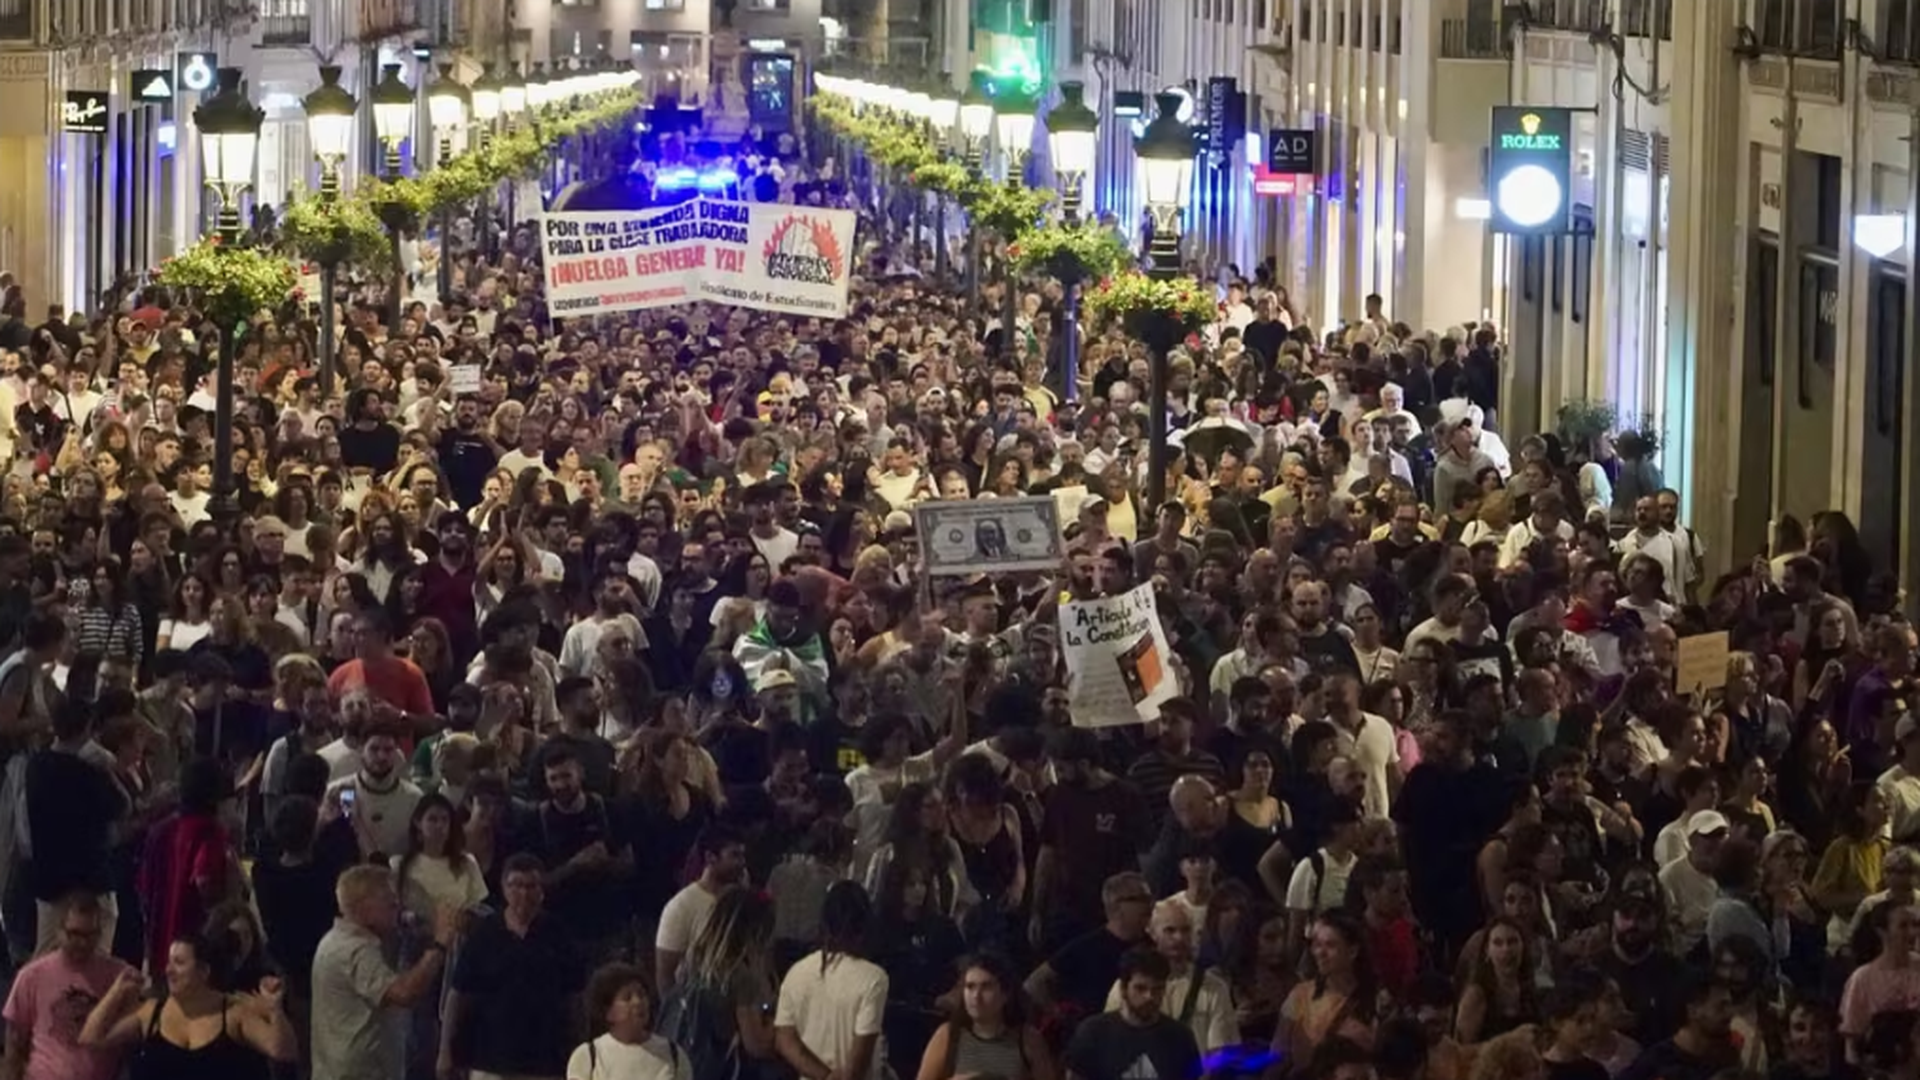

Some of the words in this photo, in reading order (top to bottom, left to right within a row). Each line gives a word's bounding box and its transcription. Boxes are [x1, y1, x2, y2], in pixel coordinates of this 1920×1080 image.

[1210, 83, 1224, 147] PRIMOR
[1501, 134, 1561, 149] ROLEX
[546, 219, 579, 237] POR
[700, 201, 749, 224] DIGNA
[548, 239, 584, 256] PARA
[588, 239, 604, 252] LA
[715, 247, 745, 273] YA!
[749, 290, 764, 301] de
